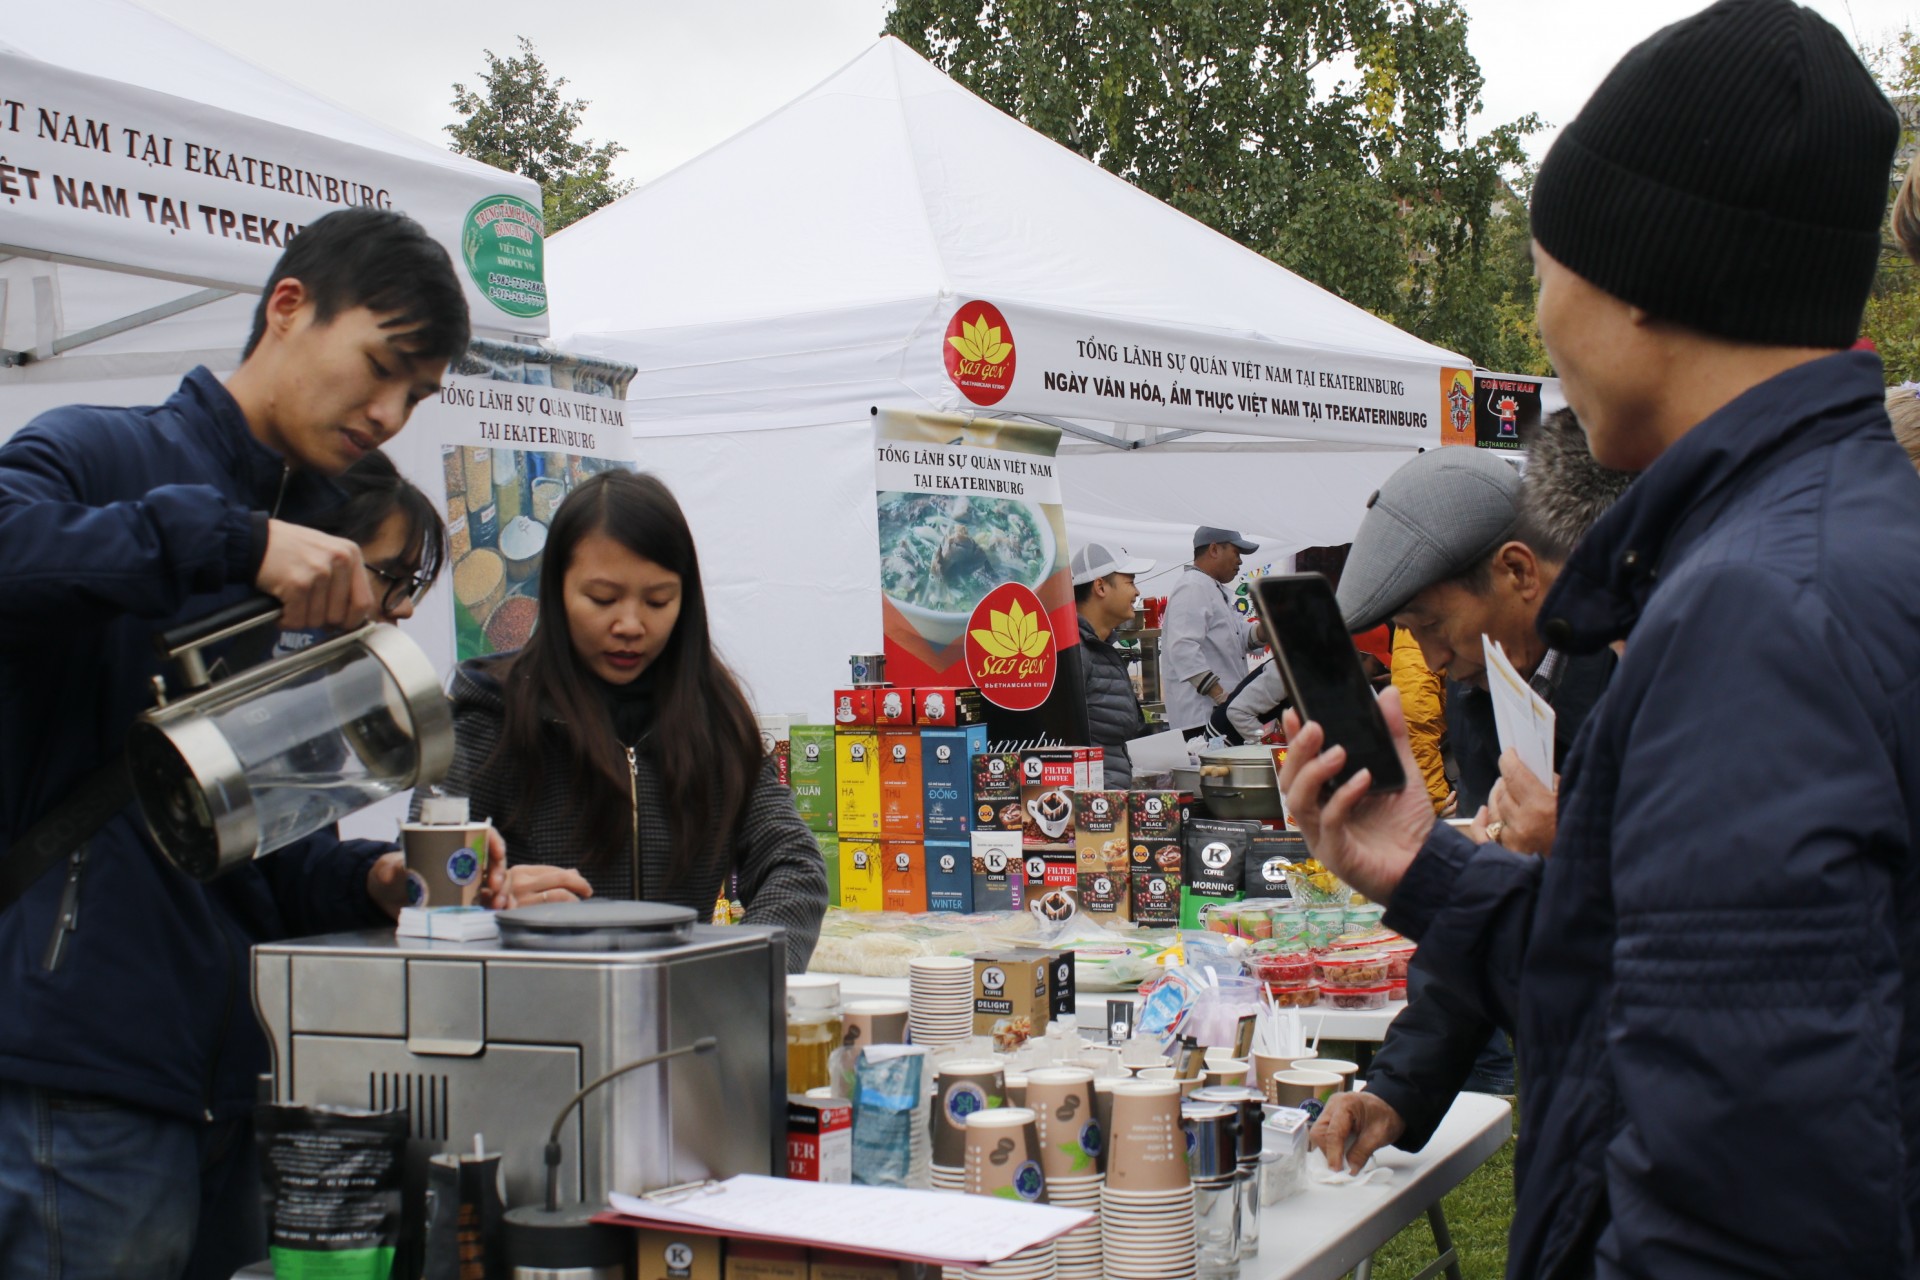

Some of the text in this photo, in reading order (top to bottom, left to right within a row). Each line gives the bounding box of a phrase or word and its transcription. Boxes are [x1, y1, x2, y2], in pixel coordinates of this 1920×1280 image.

[38, 107, 111, 153] NAM
[123, 128, 172, 167] TẠI
[185, 142, 392, 212] EKATERINBURG
[53, 174, 130, 218] NAM
[138, 192, 191, 235] TẠI
[1077, 335, 1405, 396] TỔNG LÃNH SỰ QUÁN VIỆT NAM TẠI EKATERINBURG
[1044, 370, 1428, 429] NGÀY VĂN HÓA, ẨM THỰC VIỆT NAM TẠI TP.EKATERINBURG
[479, 388, 513, 411] LÃNH
[517, 395, 535, 416] SỰ
[539, 397, 571, 418] QUÁN
[573, 403, 597, 424] VIỆT
[600, 409, 625, 427] NAM
[480, 421, 596, 450] TẠI EKATERINBURG
[878, 444, 1052, 478] TỔNG LÃNH SỰ QUÁN VIỆT NAM
[914, 473, 1024, 495] TẠI EKATERINBURG
[808, 746, 815, 754] K
[854, 746, 860, 754] K
[896, 747, 902, 755] K
[939, 748, 946, 756] K
[992, 763, 1000, 771] K
[1028, 762, 1038, 773] K
[1044, 766, 1072, 775] FILTER
[1095, 801, 1104, 810] K
[1149, 801, 1158, 810] K
[1208, 848, 1226, 862] K
[989, 854, 1001, 867] K
[1030, 862, 1041, 872] K
[1047, 867, 1075, 875] FILTER
[1098, 881, 1106, 890] K
[1153, 882, 1162, 891] K
[1192, 881, 1234, 891] MORNING
[1265, 883, 1289, 891] COFFEE
[931, 899, 962, 909] WINTER
[1060, 968, 1066, 977] K
[987, 972, 999, 984] K
[977, 1000, 1010, 1009] DELIGHT
[672, 1248, 685, 1263] K
